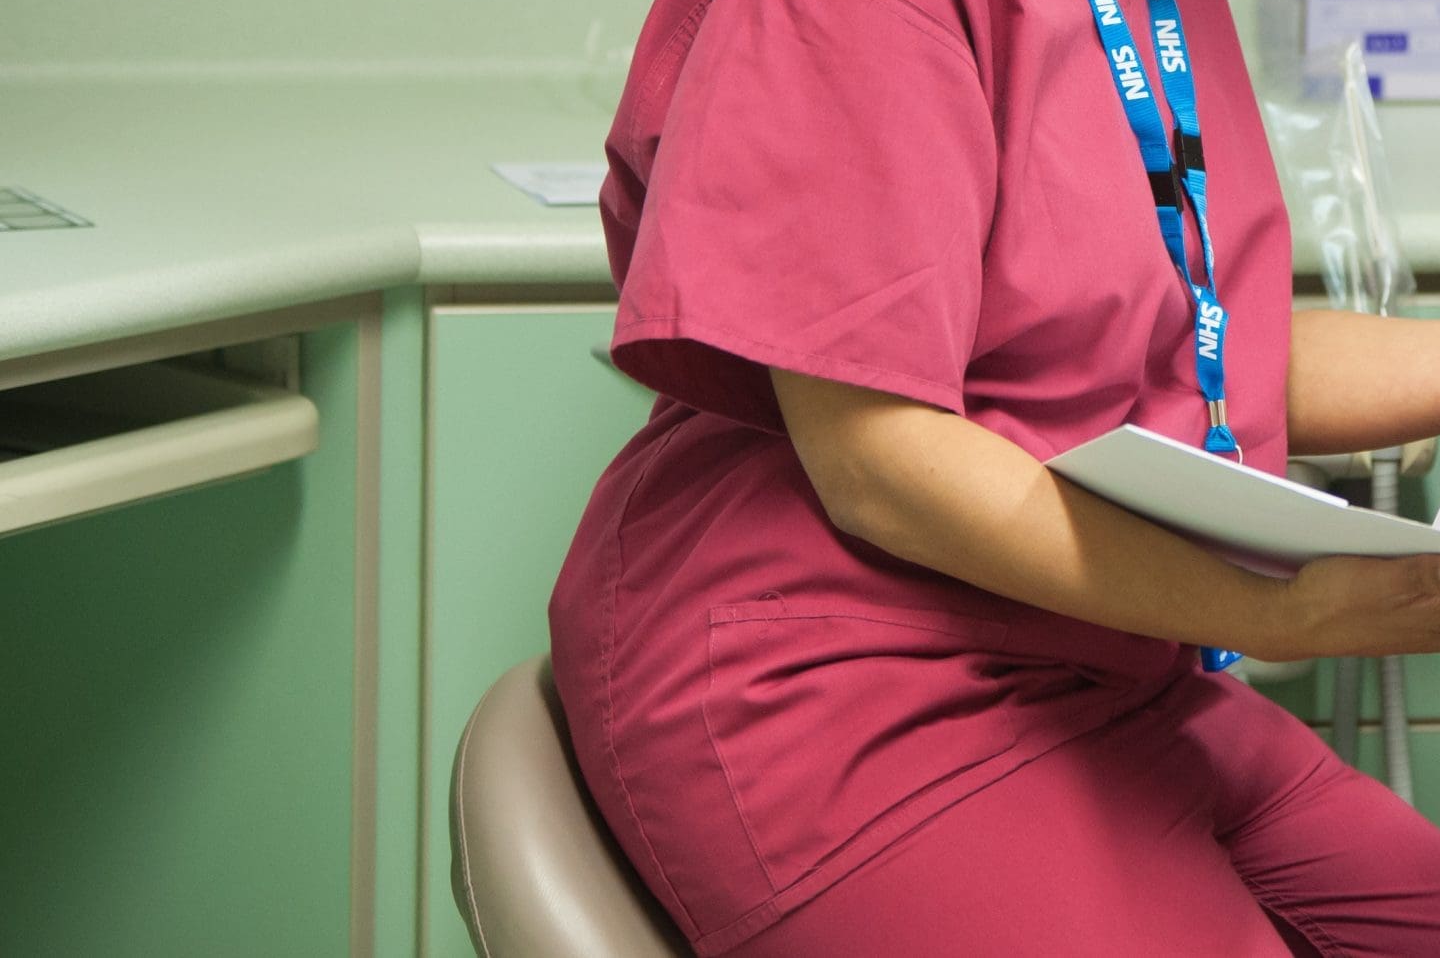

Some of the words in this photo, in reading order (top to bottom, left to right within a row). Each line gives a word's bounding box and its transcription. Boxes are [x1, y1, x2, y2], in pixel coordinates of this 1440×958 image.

[1112, 45, 1149, 101] NHS
[1155, 19, 1187, 73] NHS
[1198, 301, 1223, 360] NHS
